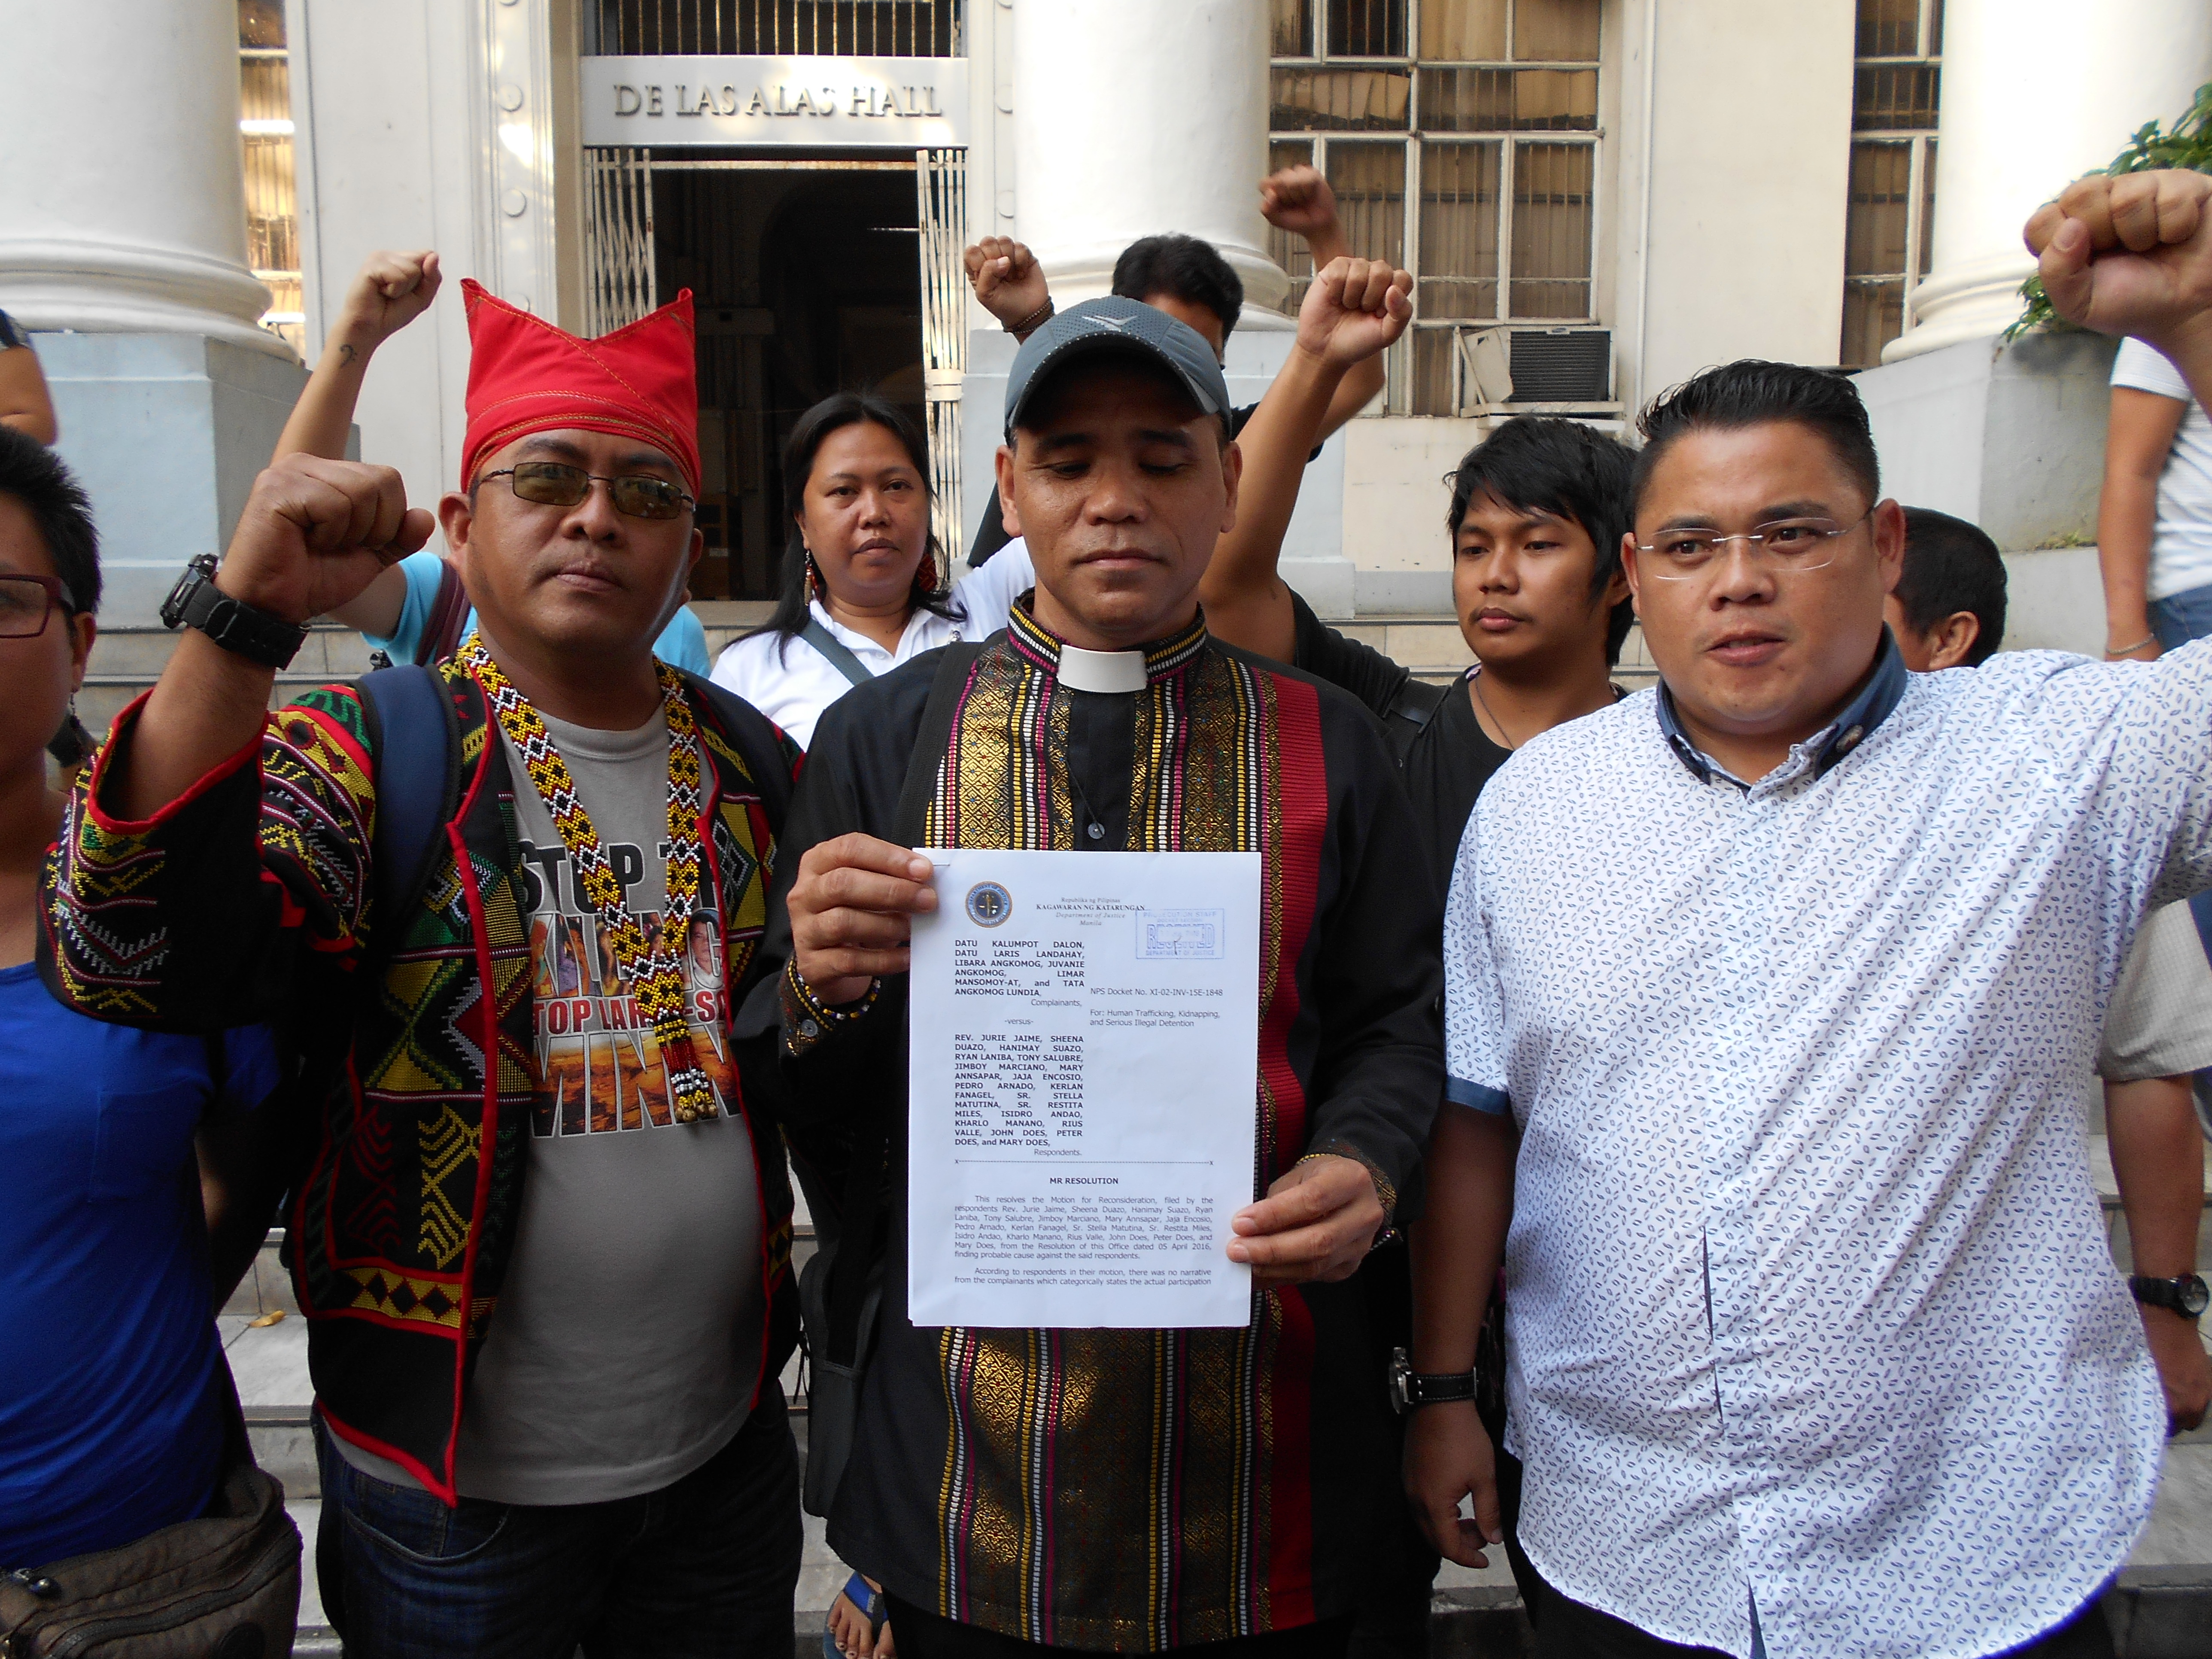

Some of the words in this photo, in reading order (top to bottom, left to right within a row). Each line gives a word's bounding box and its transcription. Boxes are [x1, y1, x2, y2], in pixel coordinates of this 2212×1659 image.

[614, 85, 662, 116] DE
[675, 85, 736, 116] LAS
[745, 85, 836, 117] ALAS
[847, 85, 943, 117] HALL
[1036, 951, 1084, 959] LANDAHAY,
[991, 960, 1043, 968] ANGKOMOG,
[955, 969, 1006, 977] ANGKOMOG,
[955, 979, 1021, 987] MANSOMOY-AT,
[1031, 999, 1082, 1007] Complainants,
[1135, 1010, 1176, 1018] Trafficking,
[1179, 1010, 1220, 1019] Kidnapping,
[1135, 1019, 1157, 1027] Illegal
[955, 1044, 986, 1052] DUAZO,
[1053, 1045, 1083, 1053] SUAZO,
[981, 1054, 1014, 1062] LANIBA,
[1043, 1054, 1083, 1063] SALUBRE,
[1034, 1149, 1082, 1157] Respondents.
[1099, 1197, 1157, 1205] Reconsideration,
[1195, 1206, 1213, 1215] Ryan
[954, 1214, 980, 1222] Laniba,
[1105, 1215, 1123, 1224] Mary
[955, 1251, 978, 1259] finding
[975, 1268, 1009, 1276] According
[1023, 1268, 1066, 1276] respondents
